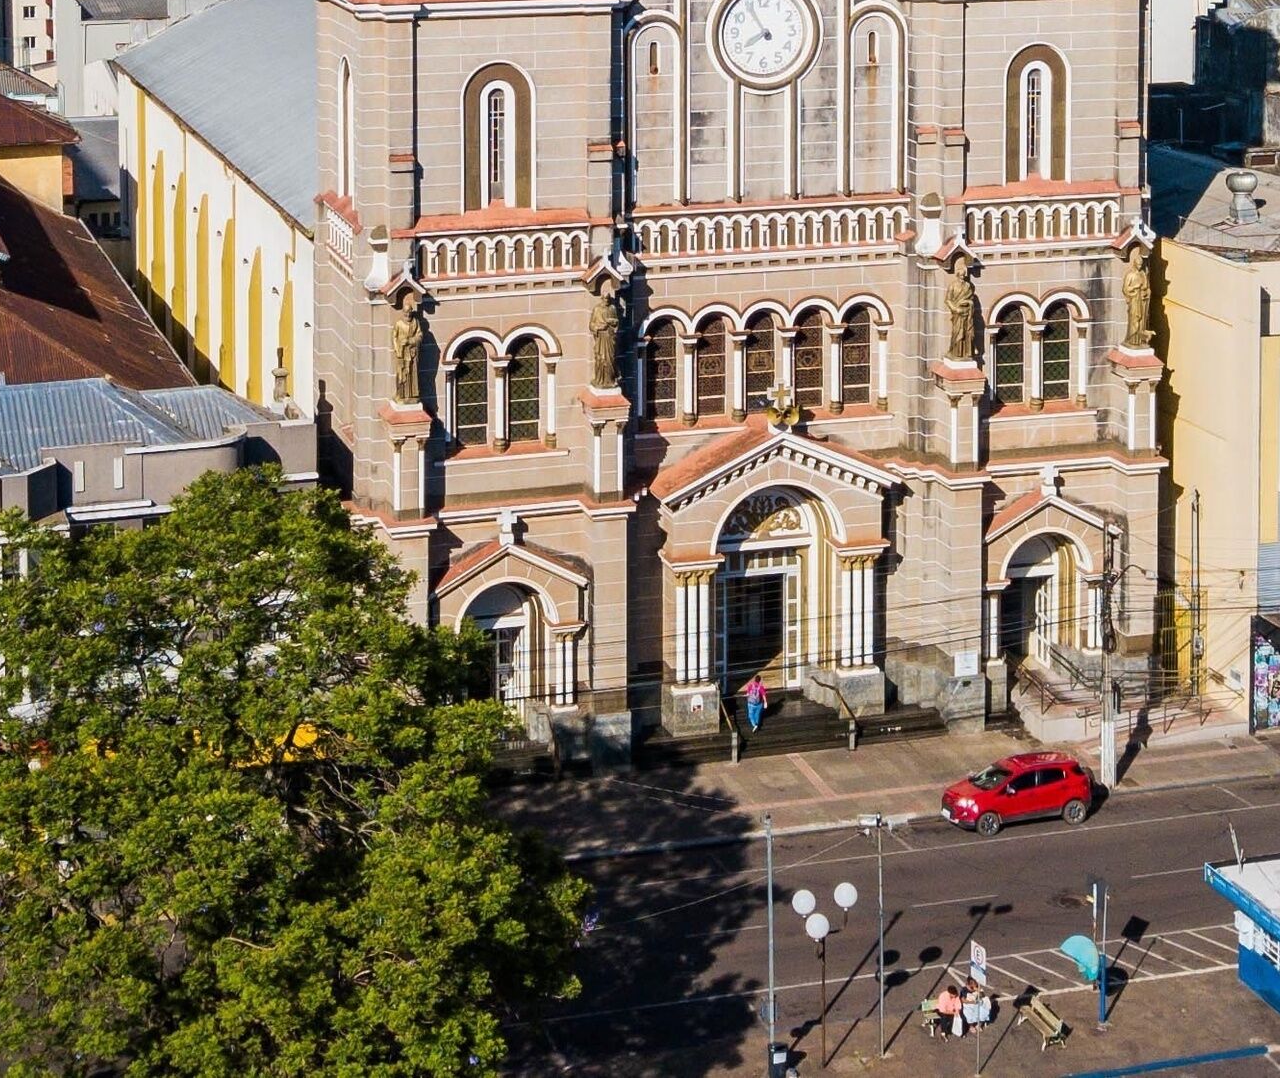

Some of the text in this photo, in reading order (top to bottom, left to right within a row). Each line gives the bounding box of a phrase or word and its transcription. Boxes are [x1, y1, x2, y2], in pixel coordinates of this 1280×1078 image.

[776, 1, 781, 13] 1
[734, 11, 746, 24] 10
[785, 10, 793, 22] 2
[730, 27, 740, 39] 9
[788, 25, 797, 37] 3
[734, 42, 743, 55] 8
[782, 41, 792, 52] 4
[745, 51, 754, 64] 7
[759, 57, 768, 69] 6
[774, 51, 783, 64] 5
